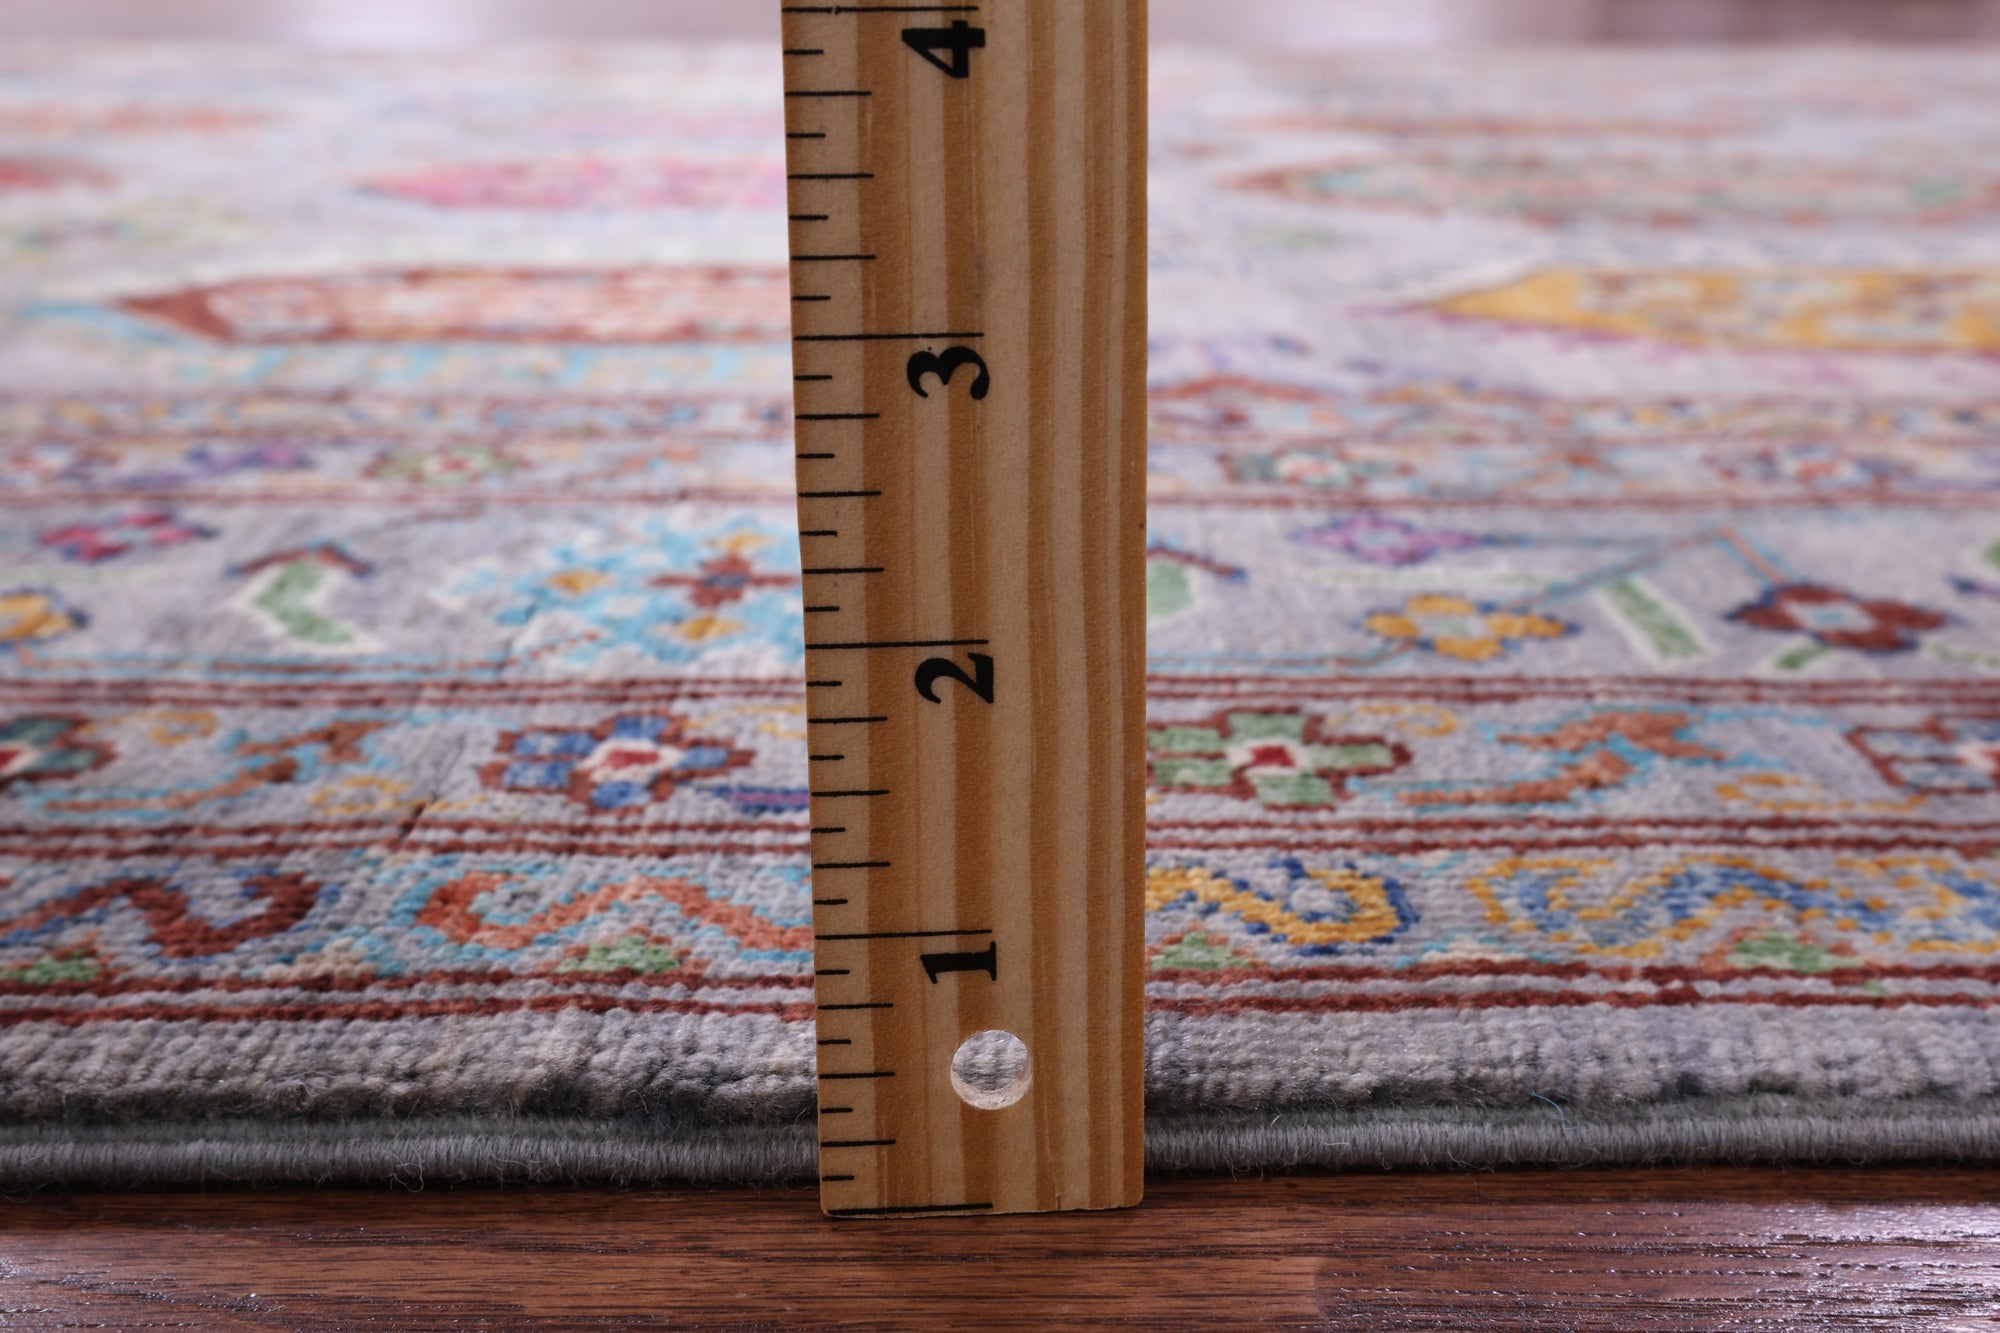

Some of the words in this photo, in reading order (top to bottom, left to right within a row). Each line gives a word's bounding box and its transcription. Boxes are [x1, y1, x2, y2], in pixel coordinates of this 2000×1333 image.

[901, 20, 985, 78] 4
[906, 346, 990, 400] 3
[914, 652, 994, 704] 2
[920, 941, 997, 984] 1
